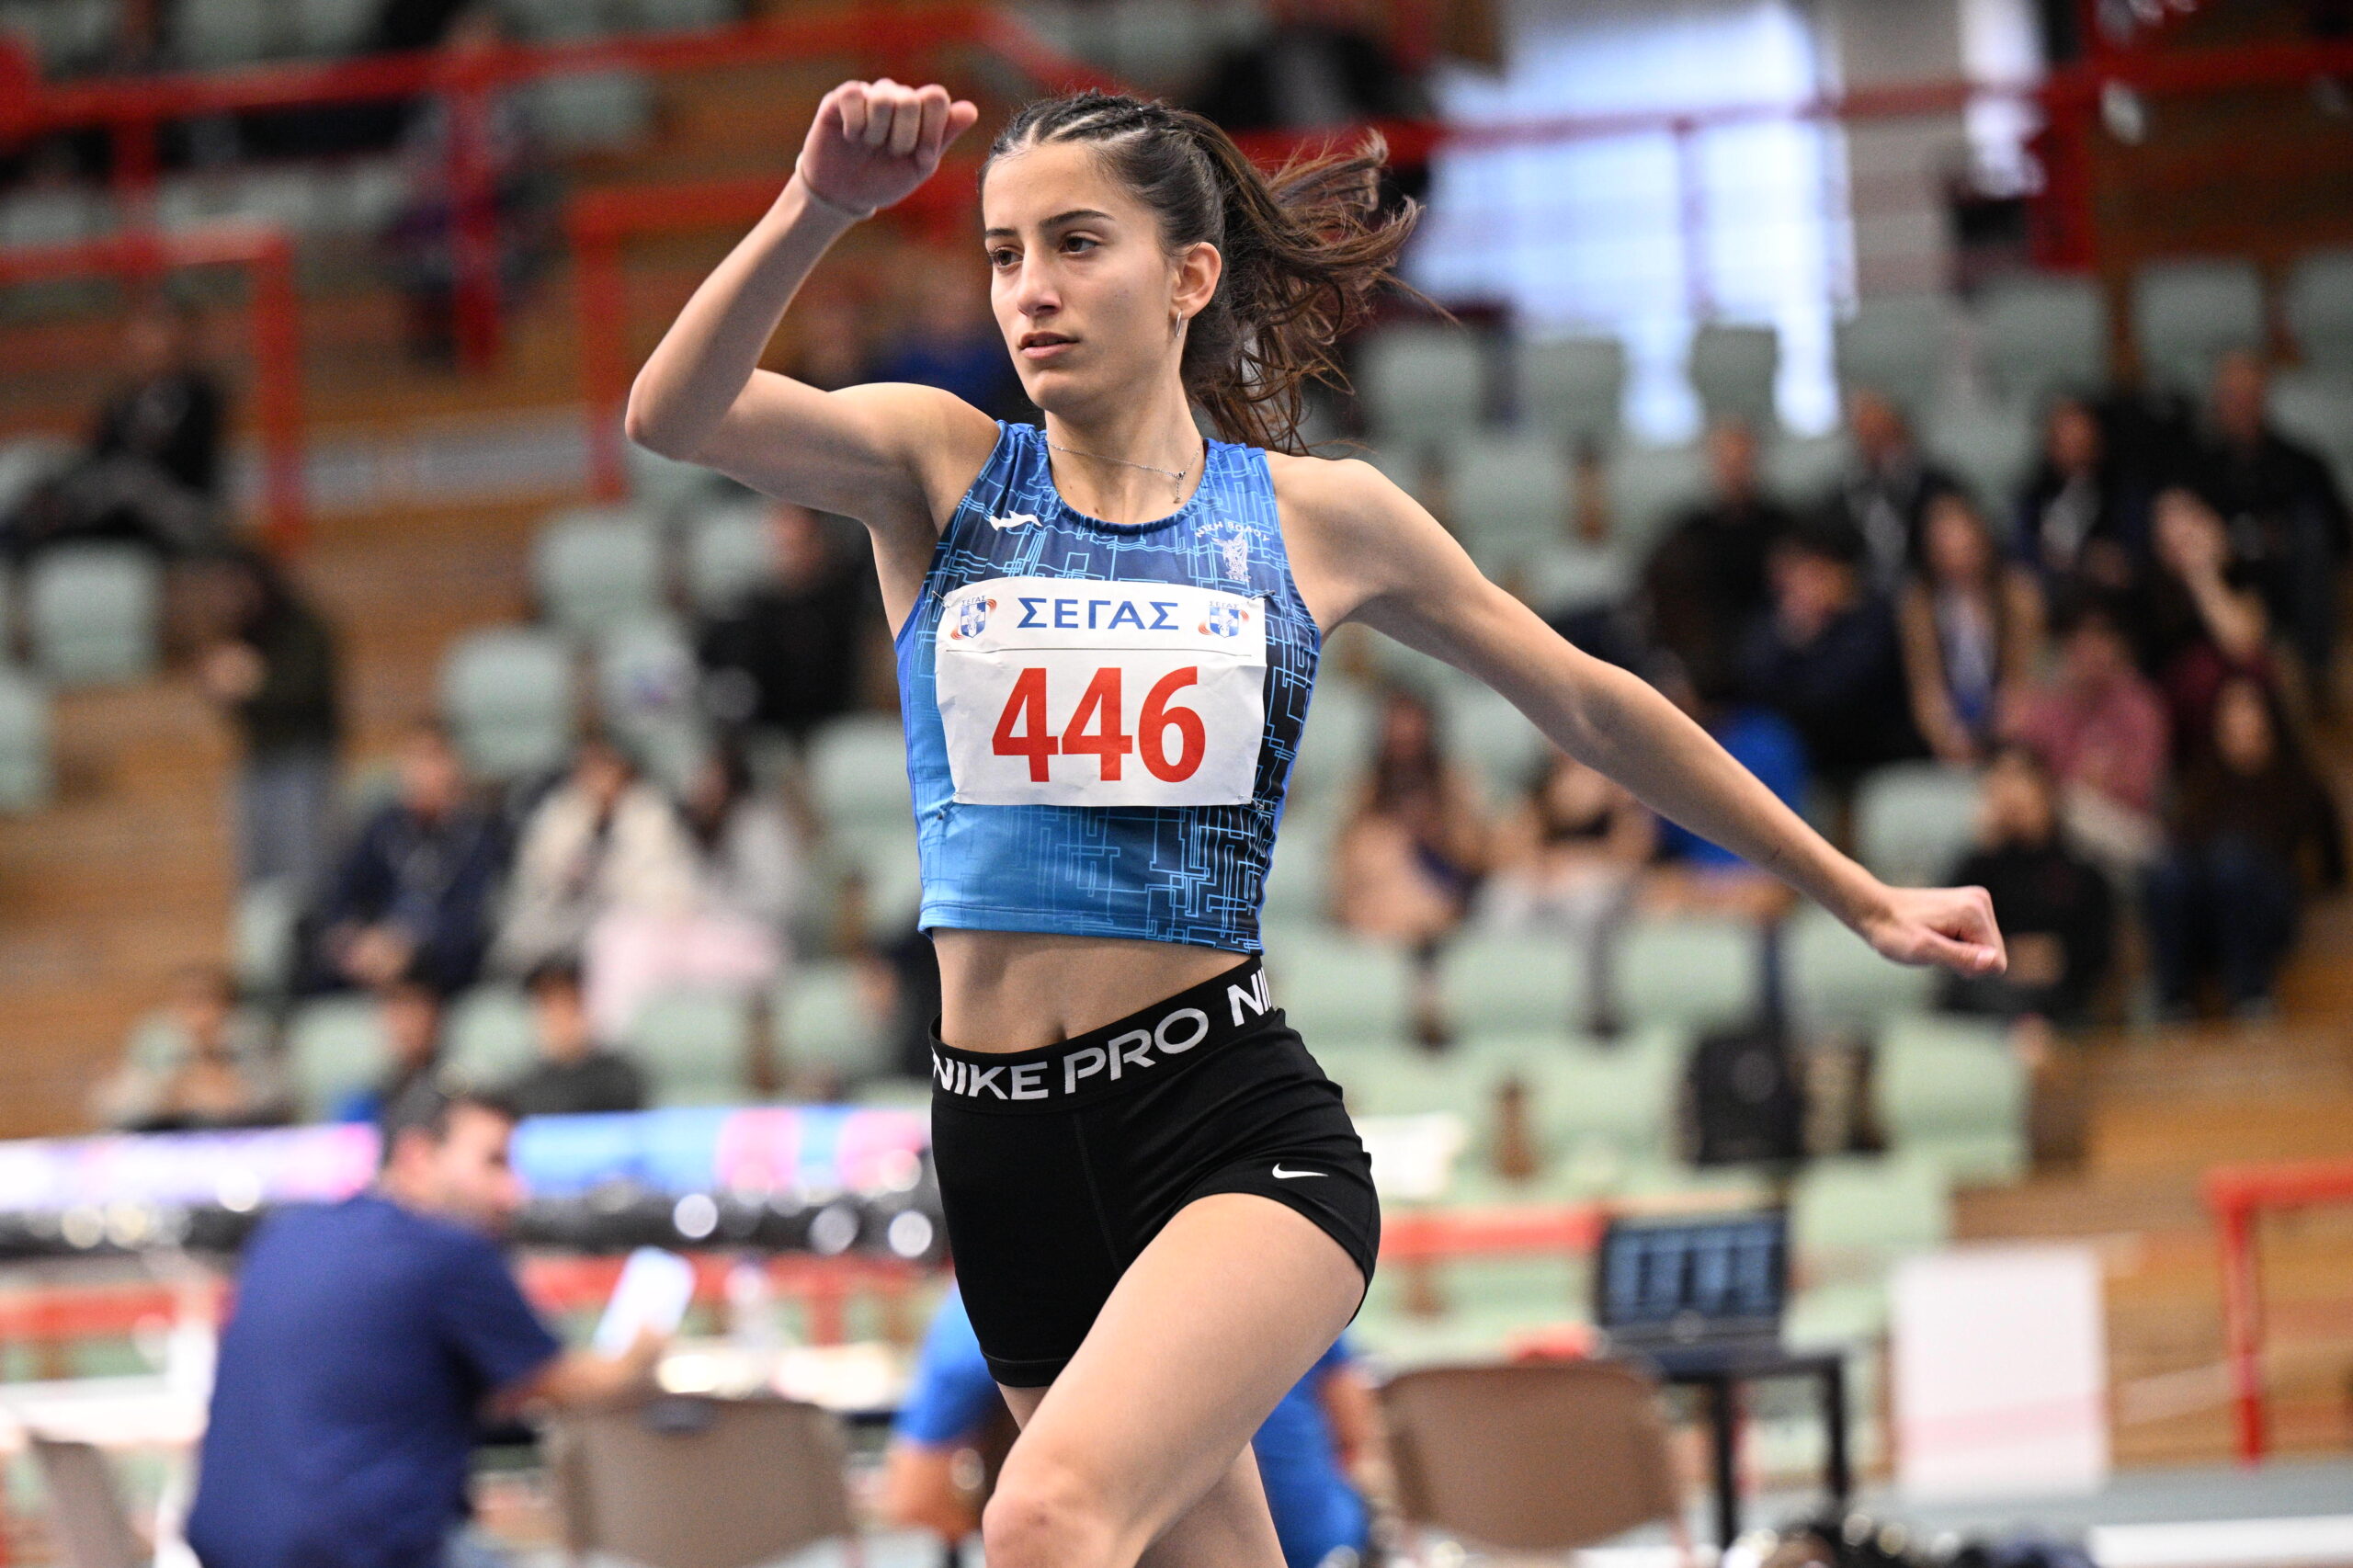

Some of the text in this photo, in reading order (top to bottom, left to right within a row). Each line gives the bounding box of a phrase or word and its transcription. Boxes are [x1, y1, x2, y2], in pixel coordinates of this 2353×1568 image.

[961, 595, 986, 607] ΣΕΓΑΣ
[1017, 597, 1179, 631] ΣΕΓΑΣ
[1209, 600, 1239, 609] ΣΕΓΑΣ
[992, 665, 1206, 783] 446
[931, 1046, 1049, 1100] NIKE
[1063, 1007, 1210, 1095] PRO
